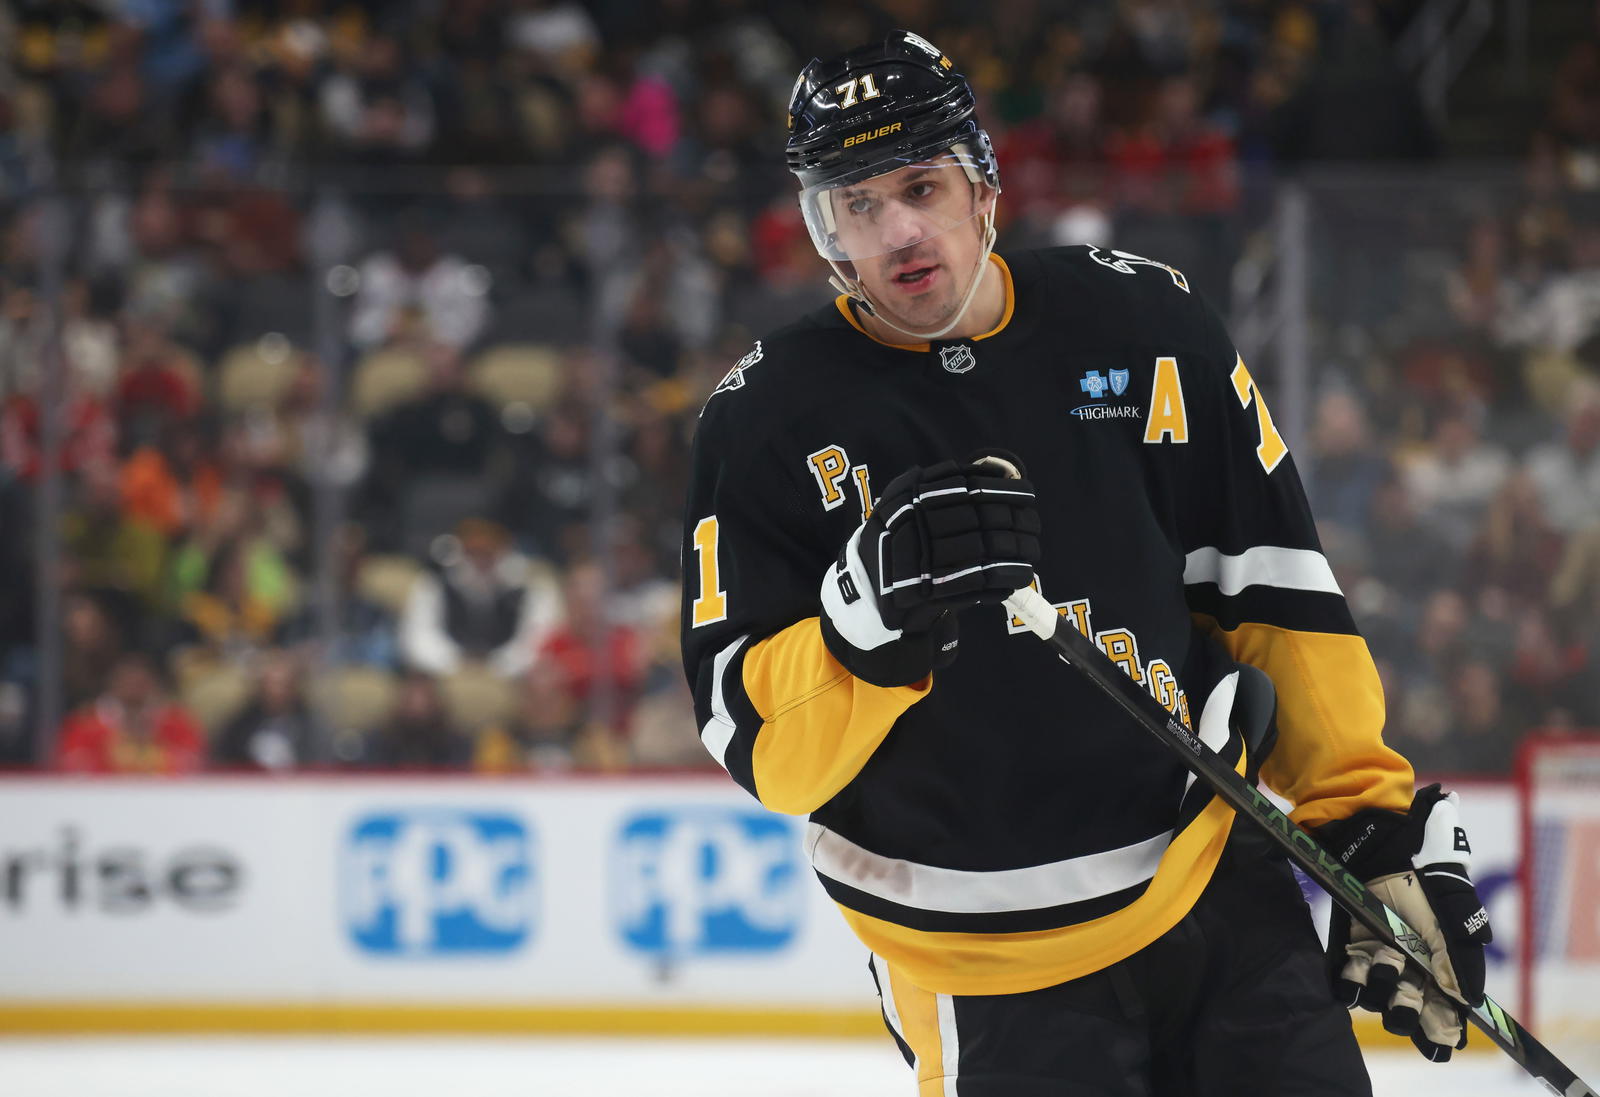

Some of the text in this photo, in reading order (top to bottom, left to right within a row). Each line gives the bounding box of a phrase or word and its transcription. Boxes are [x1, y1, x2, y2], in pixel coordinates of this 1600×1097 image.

[835, 73, 880, 110] 71
[843, 122, 902, 148] BAUER
[950, 352, 967, 369] NHL
[1079, 406, 1140, 420] HIGHMARK
[1143, 356, 1189, 443] A
[692, 514, 728, 629] 1
[338, 818, 543, 951] PPG
[608, 818, 808, 951] PPG
